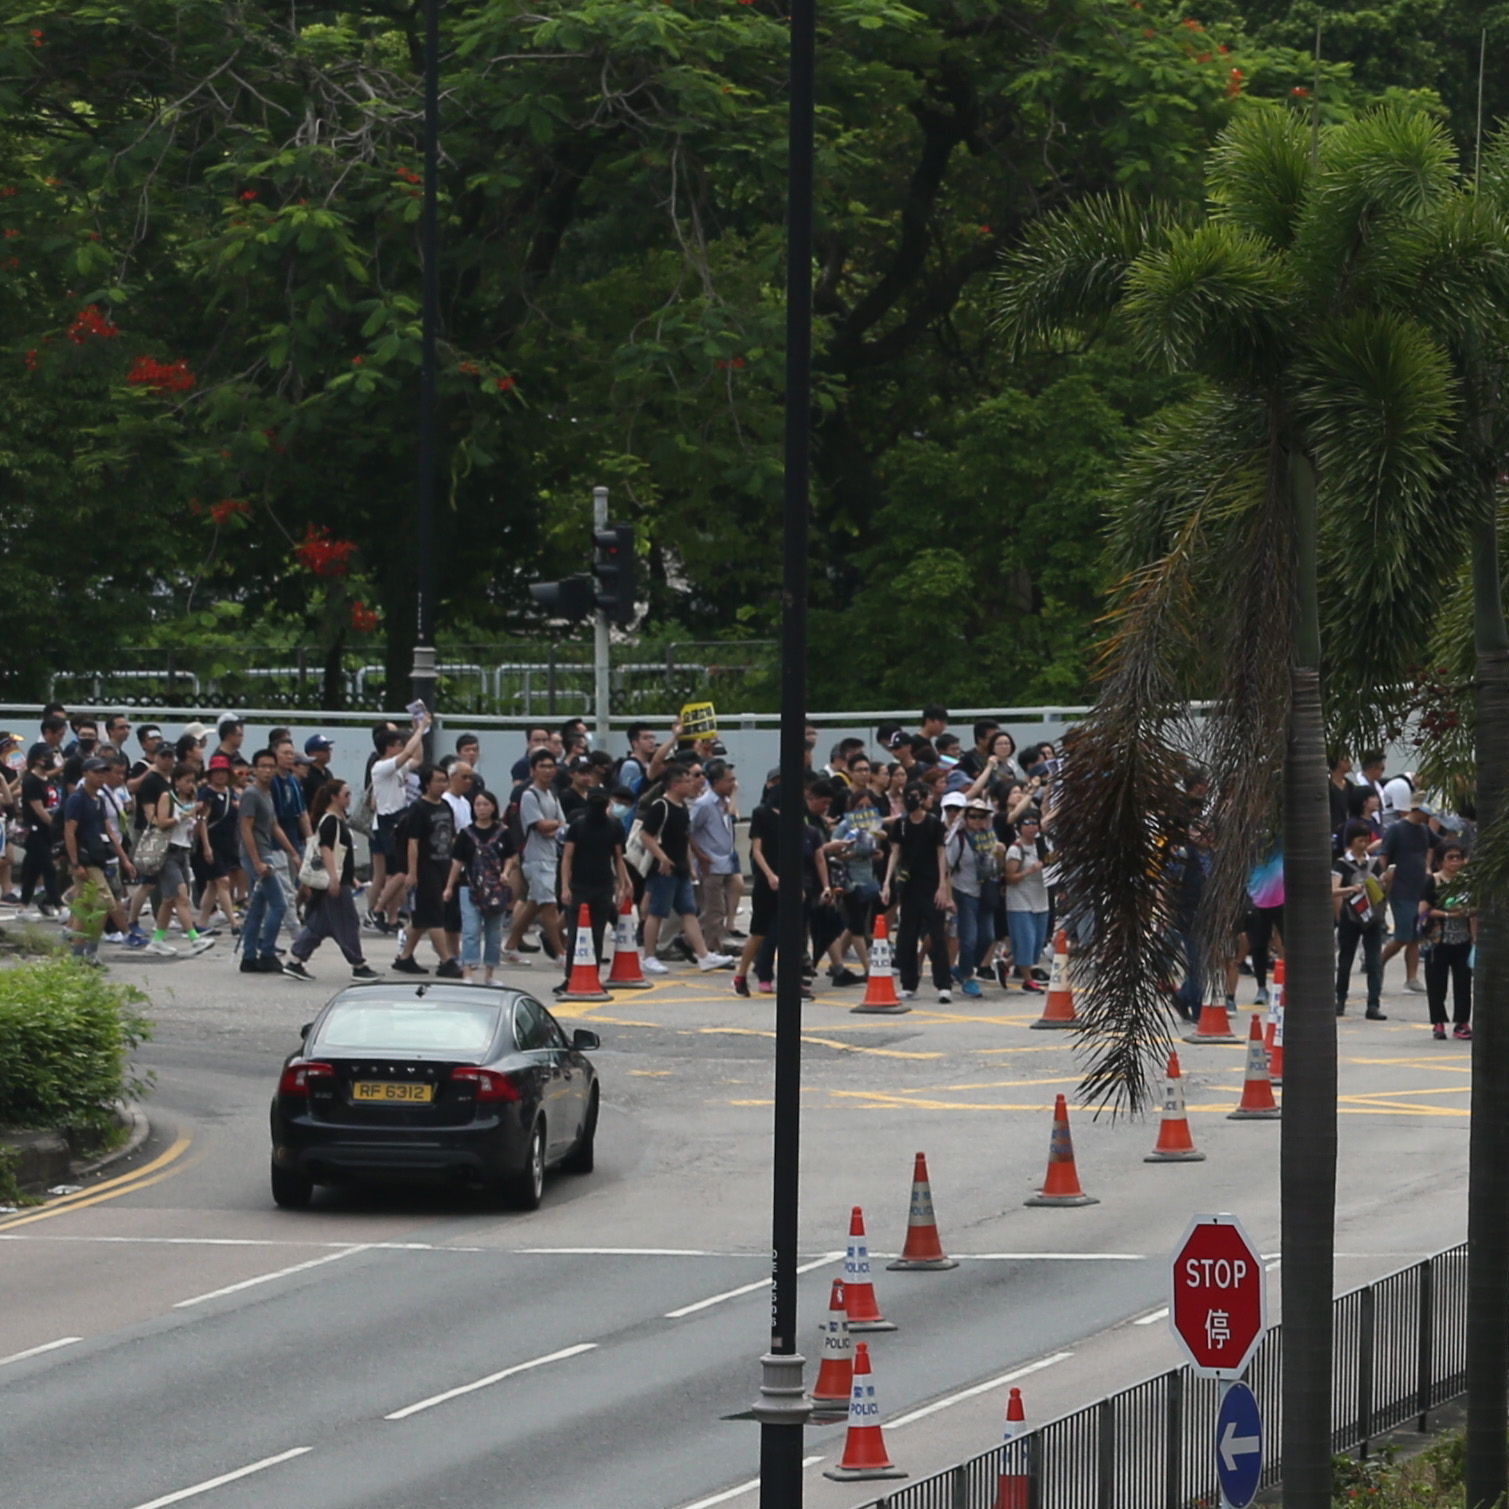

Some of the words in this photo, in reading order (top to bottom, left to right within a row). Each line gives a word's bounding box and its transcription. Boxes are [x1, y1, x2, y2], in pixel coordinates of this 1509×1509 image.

[359, 1086, 382, 1099] RF
[385, 1086, 426, 1100] 6312
[1186, 1259, 1247, 1289] STOP
[1204, 1308, 1231, 1350] 停
